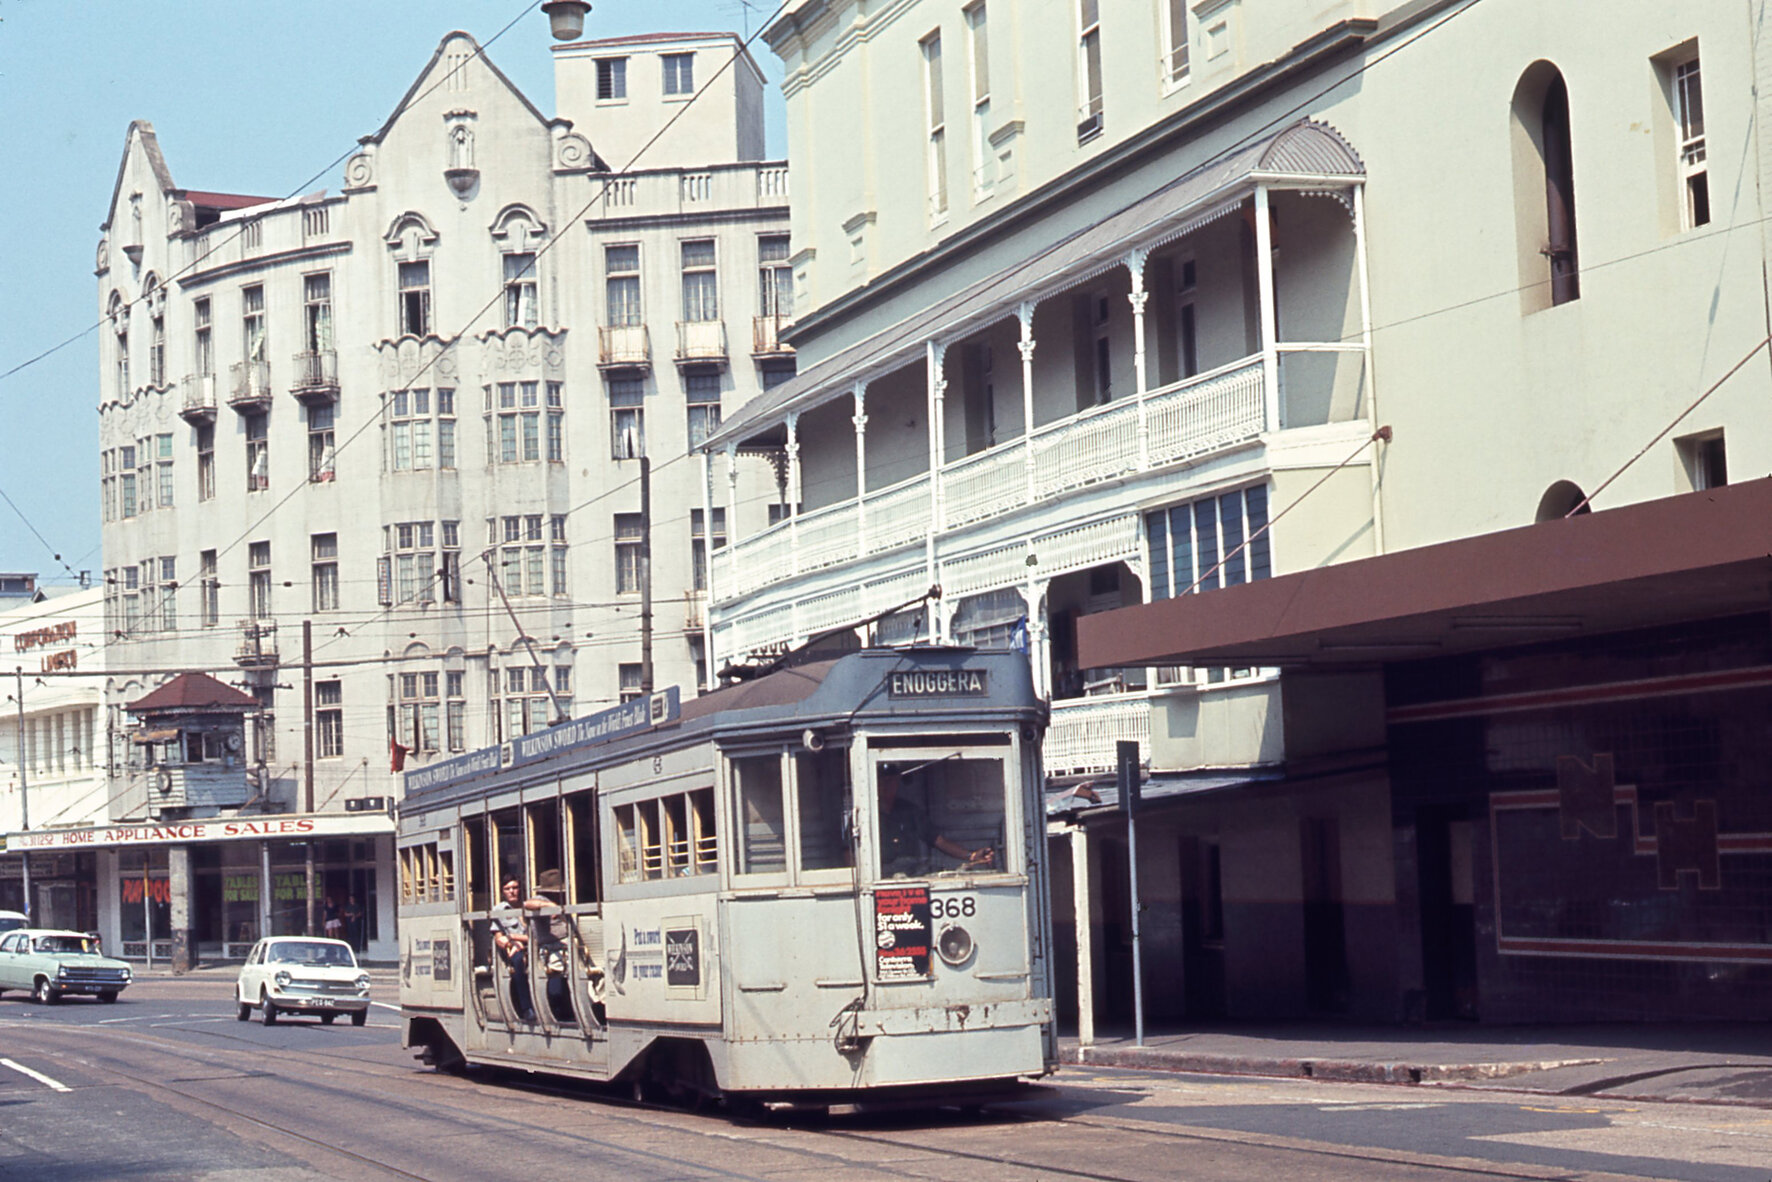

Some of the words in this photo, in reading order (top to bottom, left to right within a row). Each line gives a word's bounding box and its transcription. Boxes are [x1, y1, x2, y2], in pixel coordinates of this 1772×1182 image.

[892, 672, 982, 694] ENOGGERA
[553, 725, 576, 749] SWORD
[62, 830, 95, 844] HOME
[104, 824, 206, 842] APPLIANCE
[224, 819, 315, 836] SALES
[275, 873, 321, 888] TABLS
[296, 885, 322, 900] HIE
[930, 896, 976, 919] 368
[877, 912, 892, 923] for
[892, 911, 914, 923] only
[895, 919, 925, 930] week.
